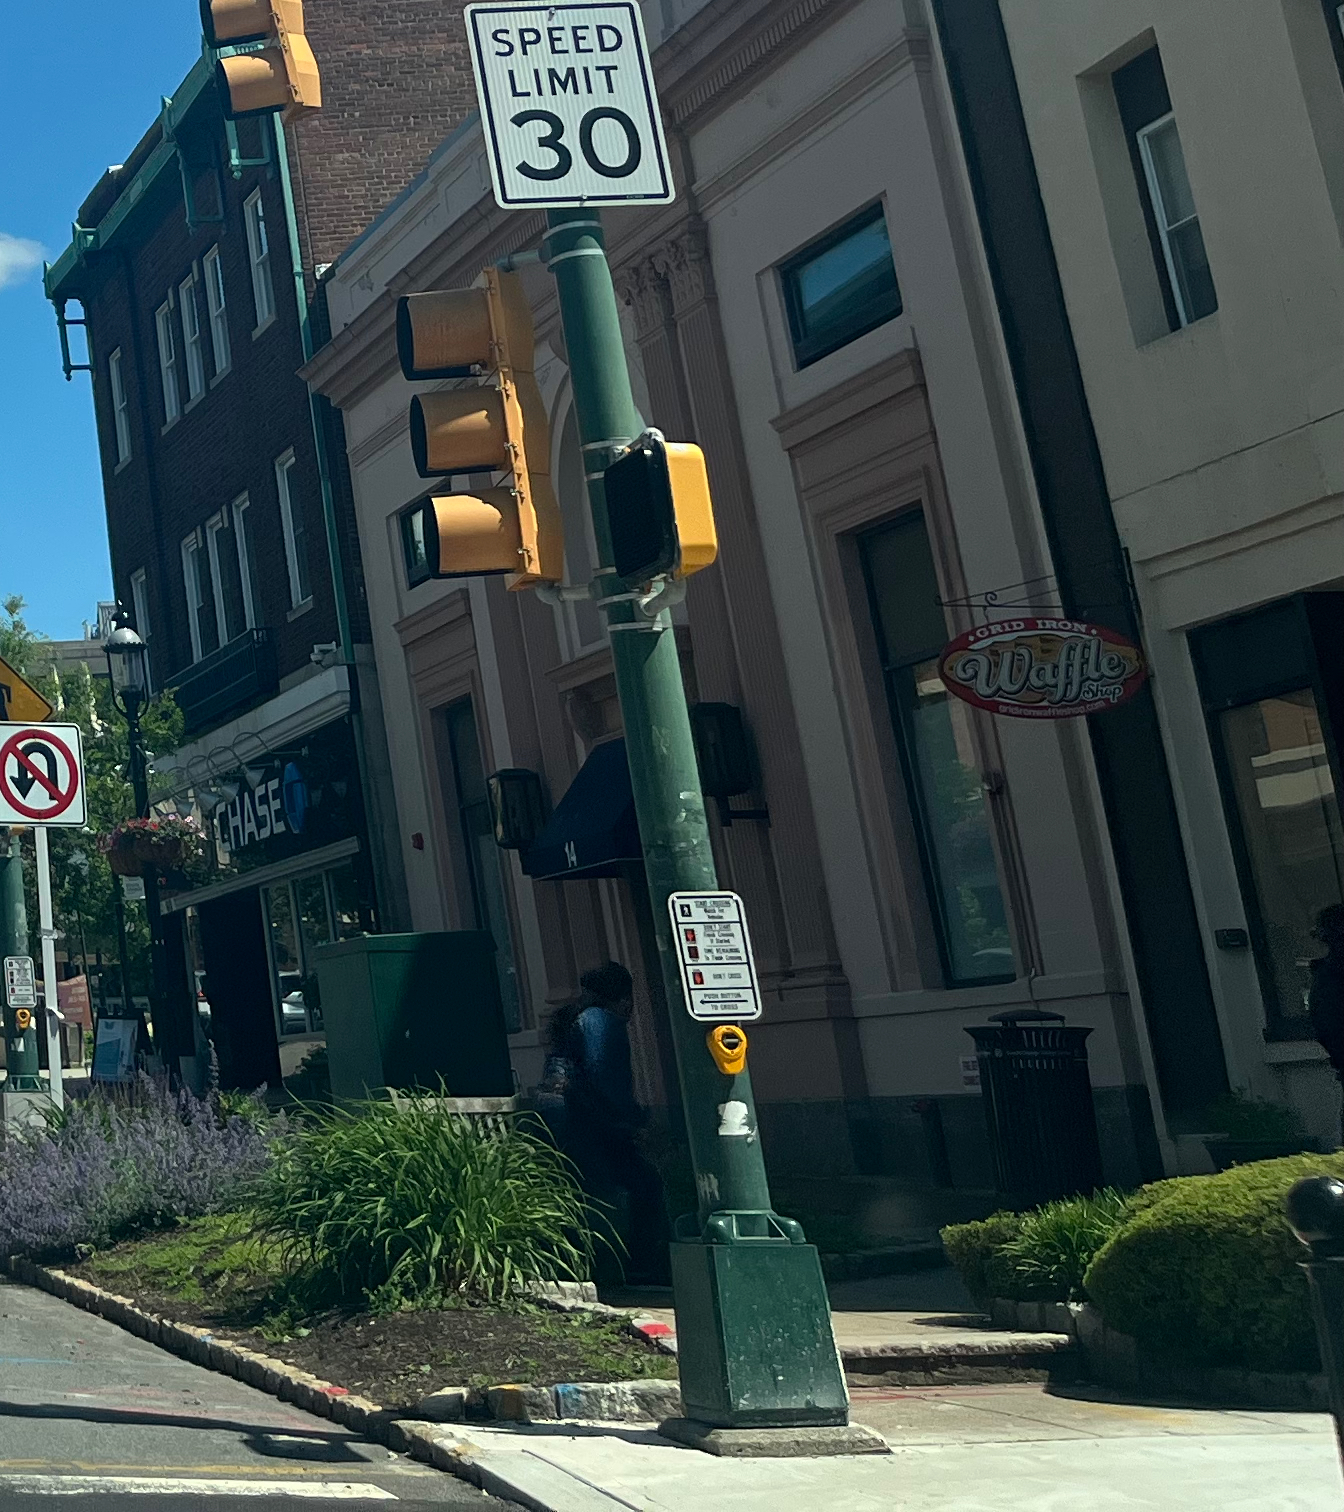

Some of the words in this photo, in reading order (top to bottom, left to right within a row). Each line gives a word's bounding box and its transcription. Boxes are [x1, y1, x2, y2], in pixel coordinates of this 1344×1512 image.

[491, 24, 623, 57] SPEED
[508, 65, 618, 98] LIMIT
[509, 106, 642, 181] 30
[975, 620, 1025, 638] GRID
[1036, 619, 1088, 634] IRON
[955, 638, 1127, 705] Waffle
[1081, 682, 1124, 703] Shop
[216, 778, 286, 852] CHASE
[564, 840, 578, 868] 14
